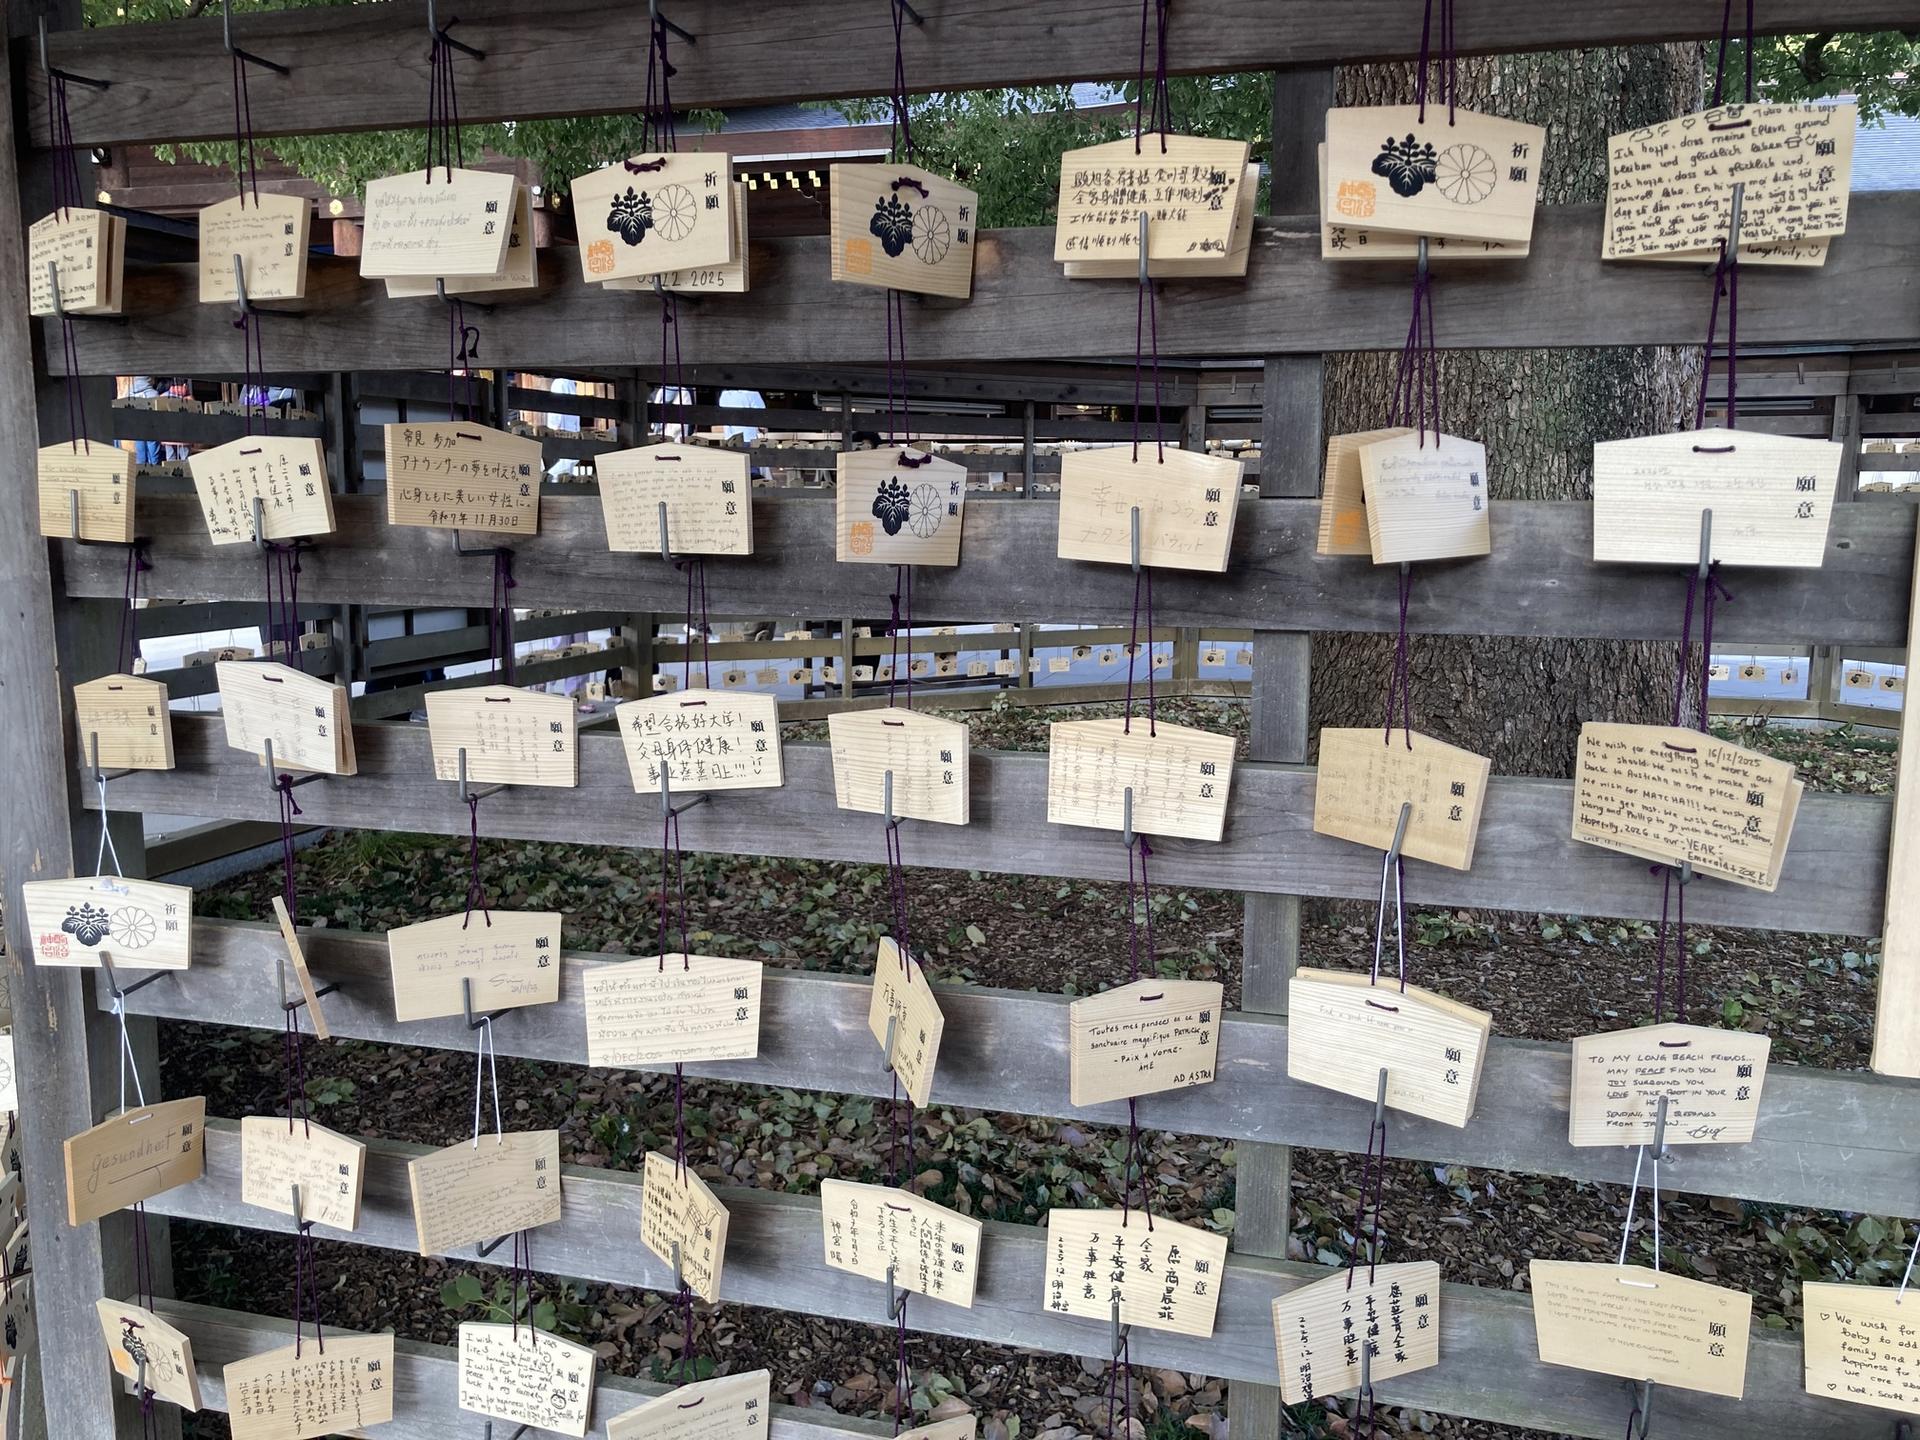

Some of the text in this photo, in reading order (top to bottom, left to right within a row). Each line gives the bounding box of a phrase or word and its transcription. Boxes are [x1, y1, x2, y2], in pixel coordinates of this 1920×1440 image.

[1613, 147, 1634, 160] Ich
[1680, 136, 1703, 147] dass
[1711, 132, 1745, 144] meine
[1751, 124, 1786, 137] Eltern
[1794, 113, 1830, 135] gesund
[1508, 142, 1529, 183] 祈願
[1614, 162, 1652, 175] bleiben
[1660, 155, 1678, 167] und
[1816, 137, 1835, 185] 願意
[703, 171, 721, 211] 祈願
[1612, 179, 1632, 191] Ich
[1674, 171, 1696, 181] dass
[1703, 165, 1717, 176] ich
[482, 200, 499, 236] 願意
[957, 204, 970, 244] 祈願
[690, 270, 725, 287] 2025
[298, 463, 316, 496] 願意
[519, 464, 530, 495] 願意
[721, 480, 737, 515] 願意
[948, 481, 960, 517] 祈願
[1203, 488, 1222, 526] 願意
[1793, 473, 1817, 519] 願意
[430, 509, 518, 526] 令和7年 11月30日
[314, 706, 329, 737] 願意
[550, 721, 565, 752] 願意
[751, 720, 768, 752] 願意
[940, 749, 954, 784] 願意
[1585, 750, 1596, 758] as
[1671, 766, 1698, 779] wish
[1718, 778, 1744, 789] make
[1586, 736, 1600, 745] We
[1605, 742, 1627, 750] wish
[1632, 746, 1644, 754] for
[1650, 747, 1699, 769] everything
[1705, 760, 1715, 768] to
[1721, 765, 1750, 777] work
[1707, 747, 1762, 767] 16/12/2025
[1198, 761, 1216, 799] 願意
[1584, 760, 1608, 774] back
[1686, 783, 1704, 793] one
[1600, 782, 1622, 790] wish
[1625, 786, 1638, 794] for
[1447, 780, 1466, 822] 願意
[1581, 789, 1591, 798] to
[1597, 794, 1615, 802] not
[1620, 800, 1635, 809] get
[165, 902, 179, 932] 祈願
[535, 936, 551, 969] 願意
[734, 988, 749, 1021] 願意
[1088, 1021, 1138, 1037] Toutes mes
[1090, 1038, 1128, 1050] sanctuaire
[1174, 1026, 1201, 1037] PATRICK
[1198, 1009, 1211, 1045] 願意
[1443, 1047, 1462, 1085] 願意
[1587, 1055, 1605, 1064] TO
[1612, 1054, 1632, 1062] MY
[1636, 1054, 1667, 1062] LONG
[1671, 1053, 1704, 1061] BEACH
[1634, 1066, 1666, 1075] PEACE
[1669, 1066, 1695, 1074] FIND
[1173, 1070, 1211, 1083] AD ASTRA
[1607, 1079, 1627, 1087] JOY
[1685, 1078, 1704, 1086] YOU
[1735, 1064, 1752, 1101] 願意
[1607, 1089, 1629, 1099] LOVE
[1636, 1089, 1661, 1097] TAKE
[338, 1163, 349, 1195] 願意
[535, 1157, 547, 1190] 願意
[951, 1242, 965, 1273] 願意
[1083, 1233, 1100, 1299] 万事胜意
[1107, 1235, 1127, 1303] 平安健康
[1138, 1237, 1154, 1274] 全家
[1193, 1259, 1209, 1296] 願意
[1414, 1293, 1429, 1330] 願意
[1834, 1311, 1915, 1336] We wish for
[476, 1334, 493, 1344] wish
[1341, 1299, 1359, 1366] 万事胜意
[1707, 1321, 1726, 1357] 願意
[1840, 1327, 1918, 1349] baby to add
[1840, 1341, 1905, 1363] family and
[1841, 1355, 1889, 1371] happiness
[367, 1359, 382, 1391] 願意
[465, 1358, 474, 1368] I
[475, 1363, 494, 1373] wish
[517, 1368, 533, 1381] love
[1870, 1376, 1894, 1385] care
[744, 1398, 759, 1427] 願意
